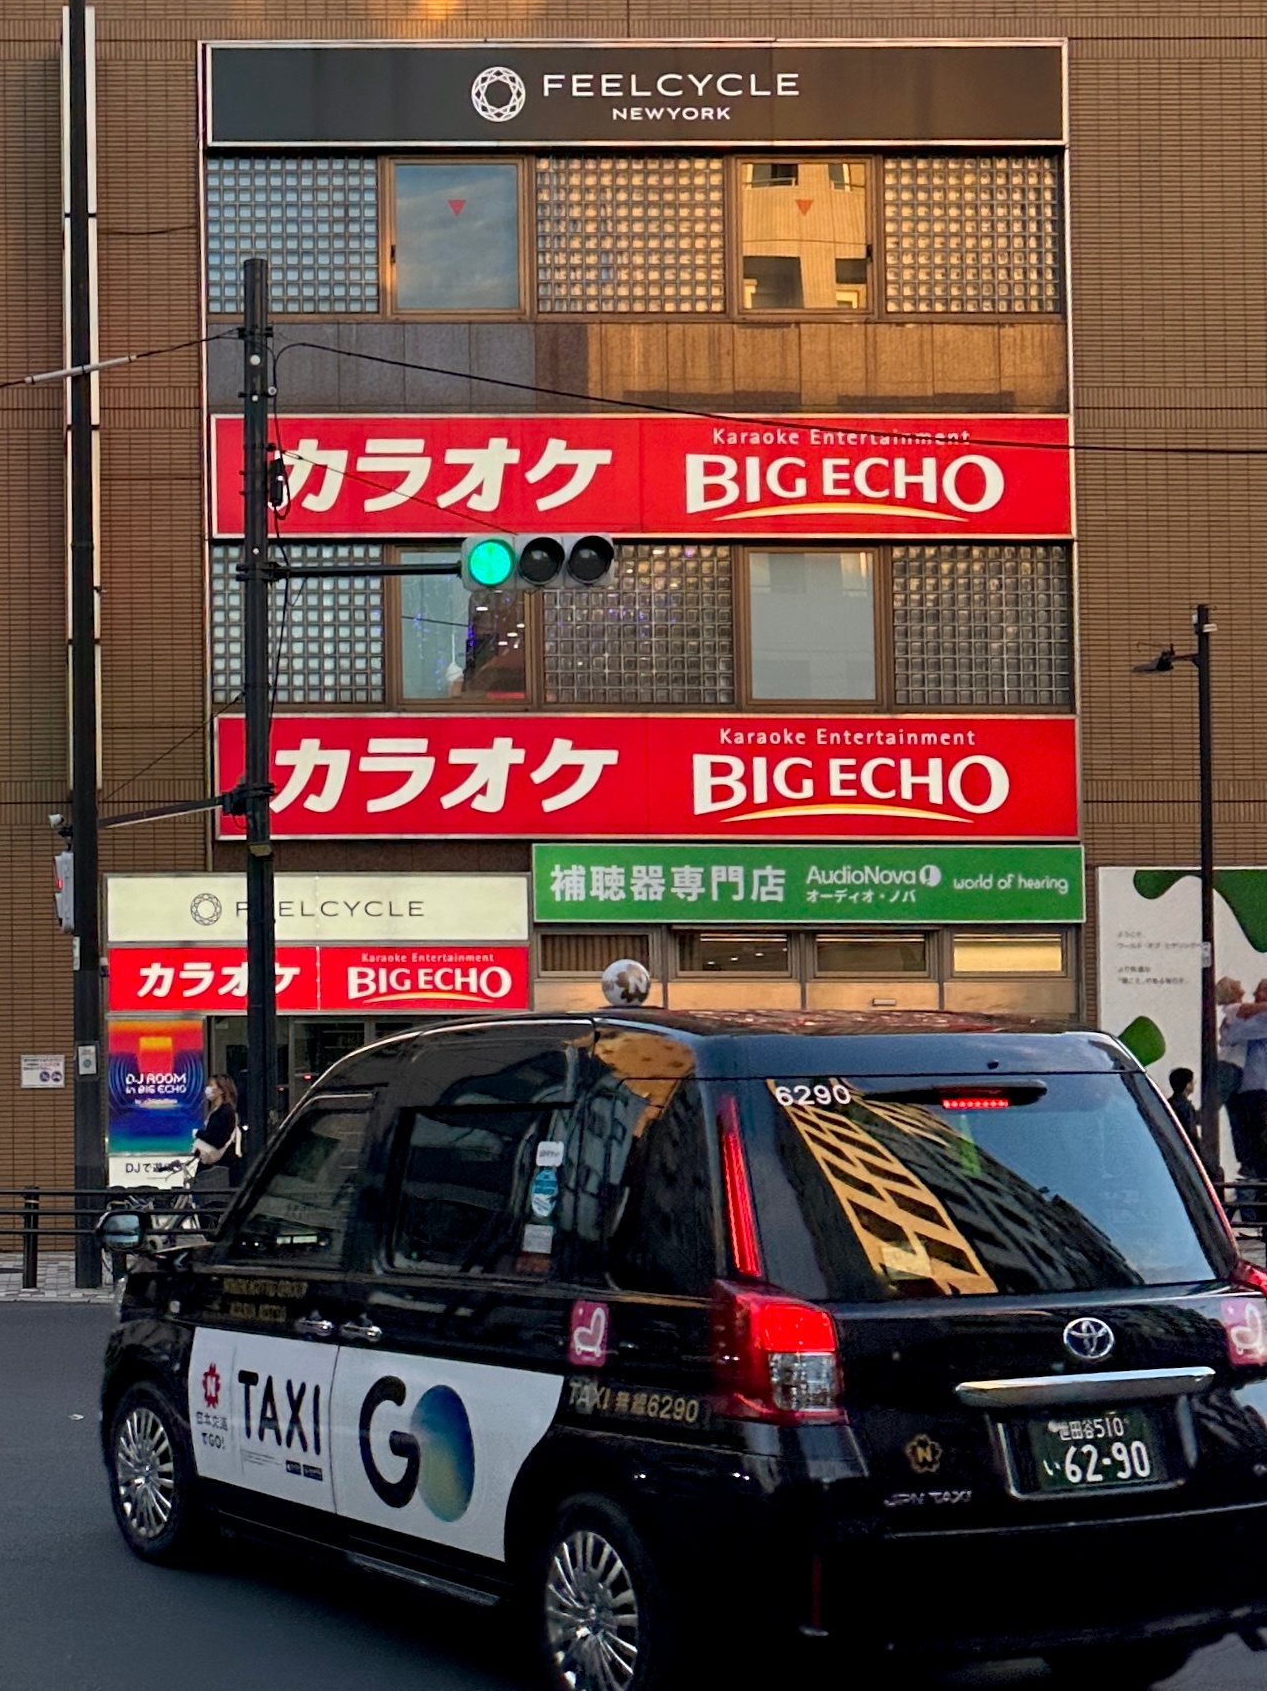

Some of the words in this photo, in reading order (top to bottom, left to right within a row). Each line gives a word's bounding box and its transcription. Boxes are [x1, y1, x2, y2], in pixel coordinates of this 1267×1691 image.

[543, 73, 800, 97] FEELCYCLE
[713, 428, 800, 445] Karaoke
[810, 428, 971, 446] Entertainment
[268, 437, 613, 512] カラオケ
[685, 453, 807, 514] BIG
[822, 454, 1005, 513] ECHO
[720, 727, 806, 745] Karaoke
[817, 727, 976, 746] Entertainment
[270, 737, 619, 813] カラオケ
[692, 753, 814, 815] BIG
[828, 754, 1010, 813] ECHO
[550, 864, 786, 901] 補聴器専門店
[806, 864, 916, 885] AudioNova
[953, 874, 993, 889] world
[997, 874, 1014, 889] of
[1018, 875, 1069, 894] hearing
[806, 889, 916, 903] オーディオ・ノバ
[235, 900, 425, 917] FELCYCLE
[361, 952, 407, 962] Karaoke
[412, 952, 494, 963] Entertainment
[348, 966, 412, 1000] BIG
[418, 966, 512, 999] ECHO
[125, 1073, 145, 1084] DJ
[146, 1073, 187, 1084] ROOM
[138, 1084, 156, 1094] BIG
[157, 1084, 187, 1094] ECHO
[775, 1084, 851, 1107] 6290
[569, 1382, 611, 1410] TAXI
[196, 1411, 228, 1432] 日本交通
[238, 1369, 321, 1456] TAXI
[1064, 1440, 1151, 1483] 62-90
[929, 1490, 973, 1503] TAXI
